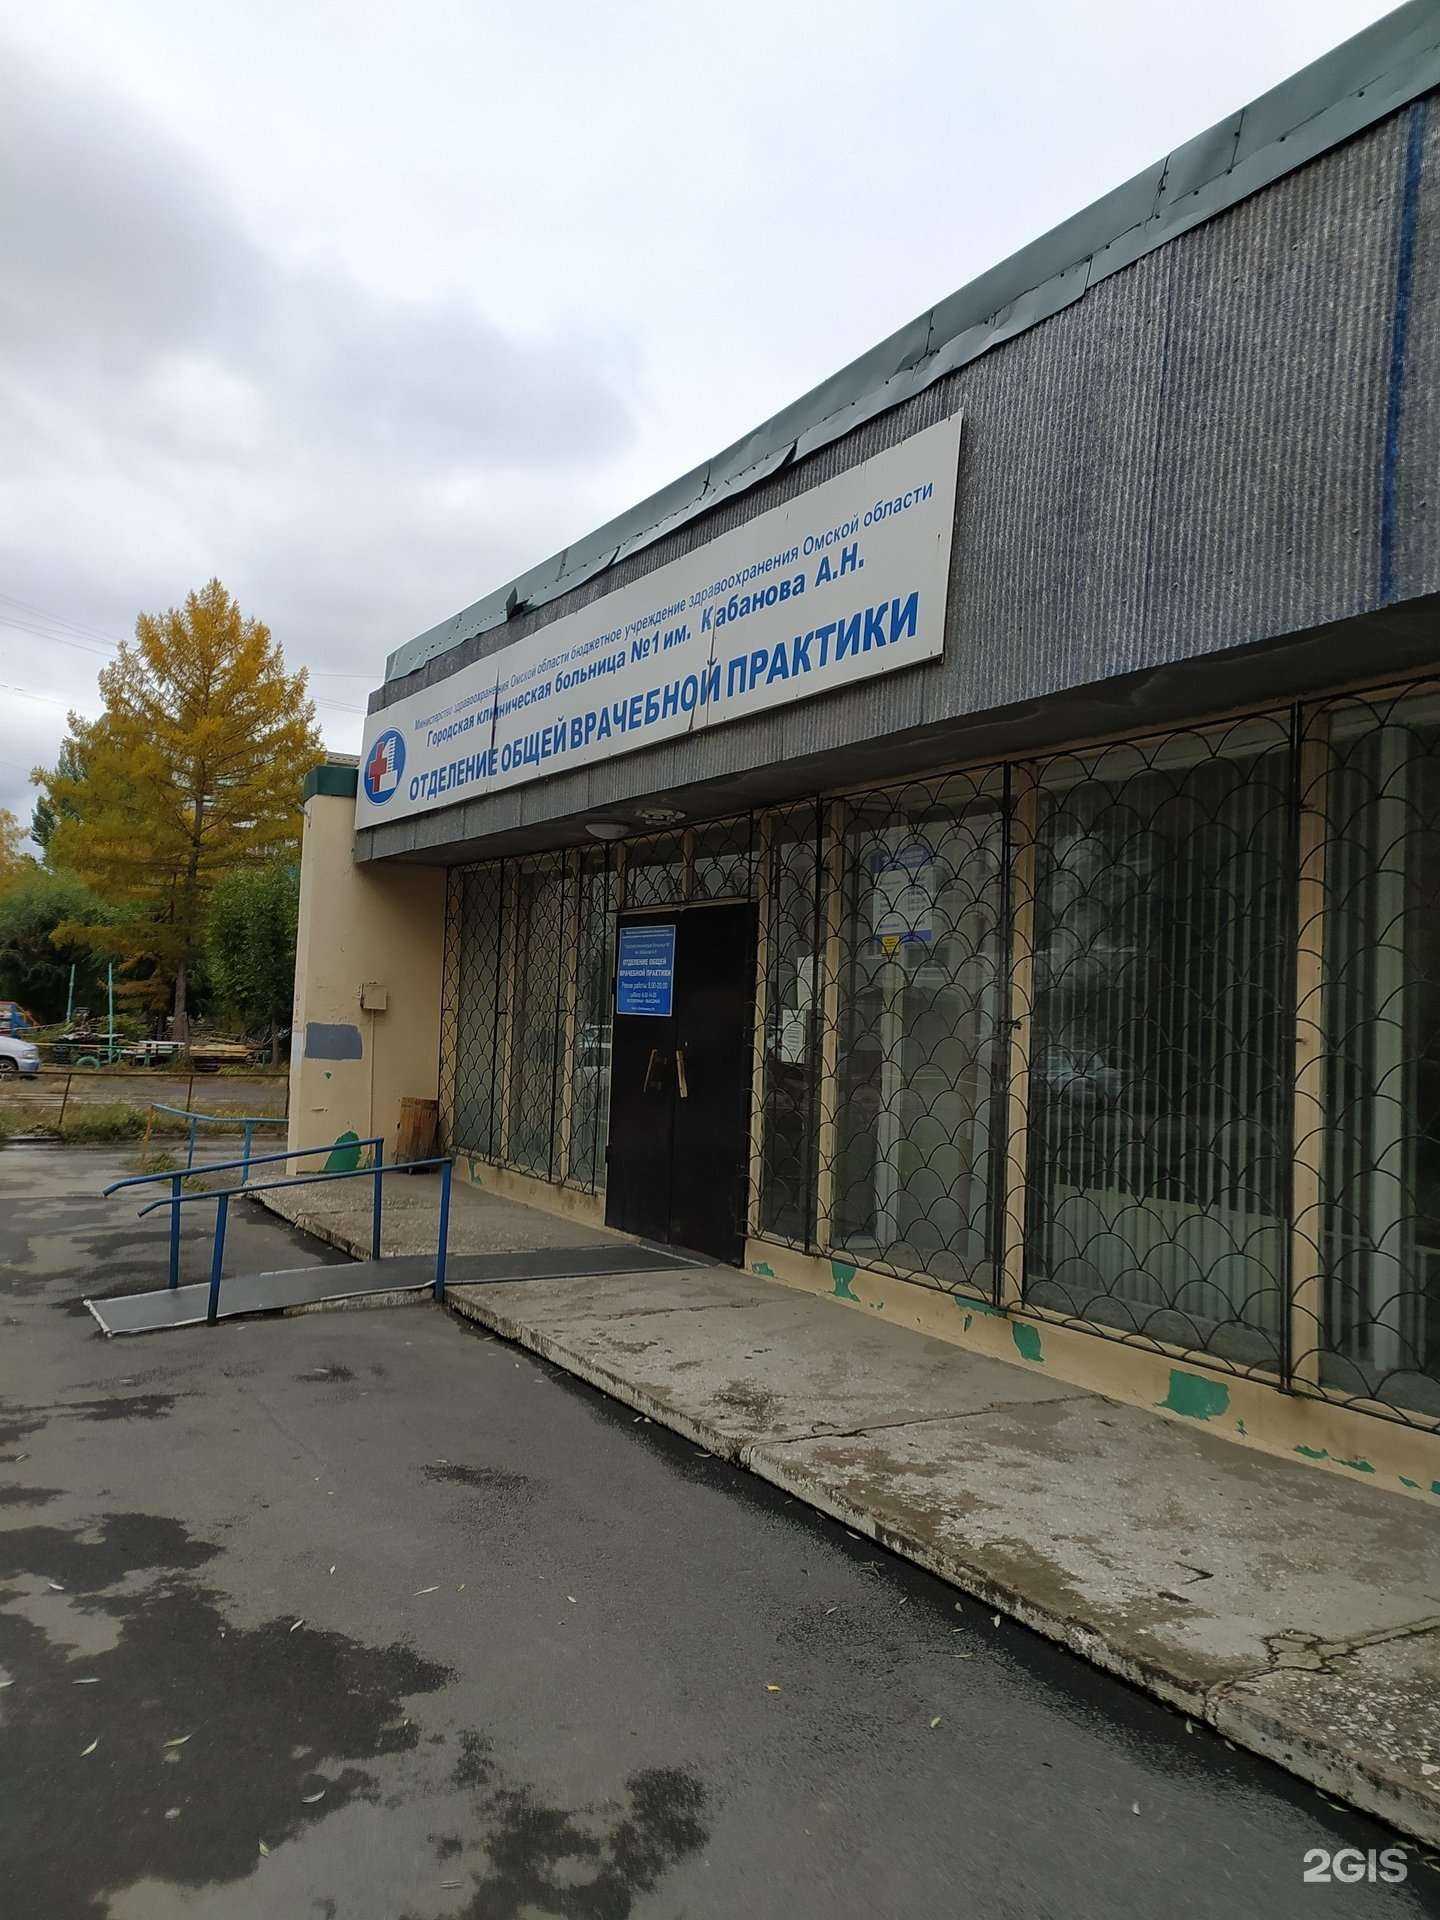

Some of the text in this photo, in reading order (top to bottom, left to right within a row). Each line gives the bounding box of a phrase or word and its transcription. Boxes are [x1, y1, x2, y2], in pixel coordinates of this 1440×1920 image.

[427, 542, 865, 747] Городская клиническая больница №1 им. Кабанова А.Н.
[511, 667, 537, 688] Омской
[537, 652, 570, 674] области
[571, 627, 622, 660] бюджетное
[624, 599, 687, 642] учреждение
[688, 546, 799, 609] здравоохранения
[803, 513, 860, 556] Омской
[864, 482, 934, 527] области
[409, 591, 919, 801] ОТДЕЛЕНИЕ ОБЩЕЙ ВРАЧЕБНОЙ ПРАКТИКИ
